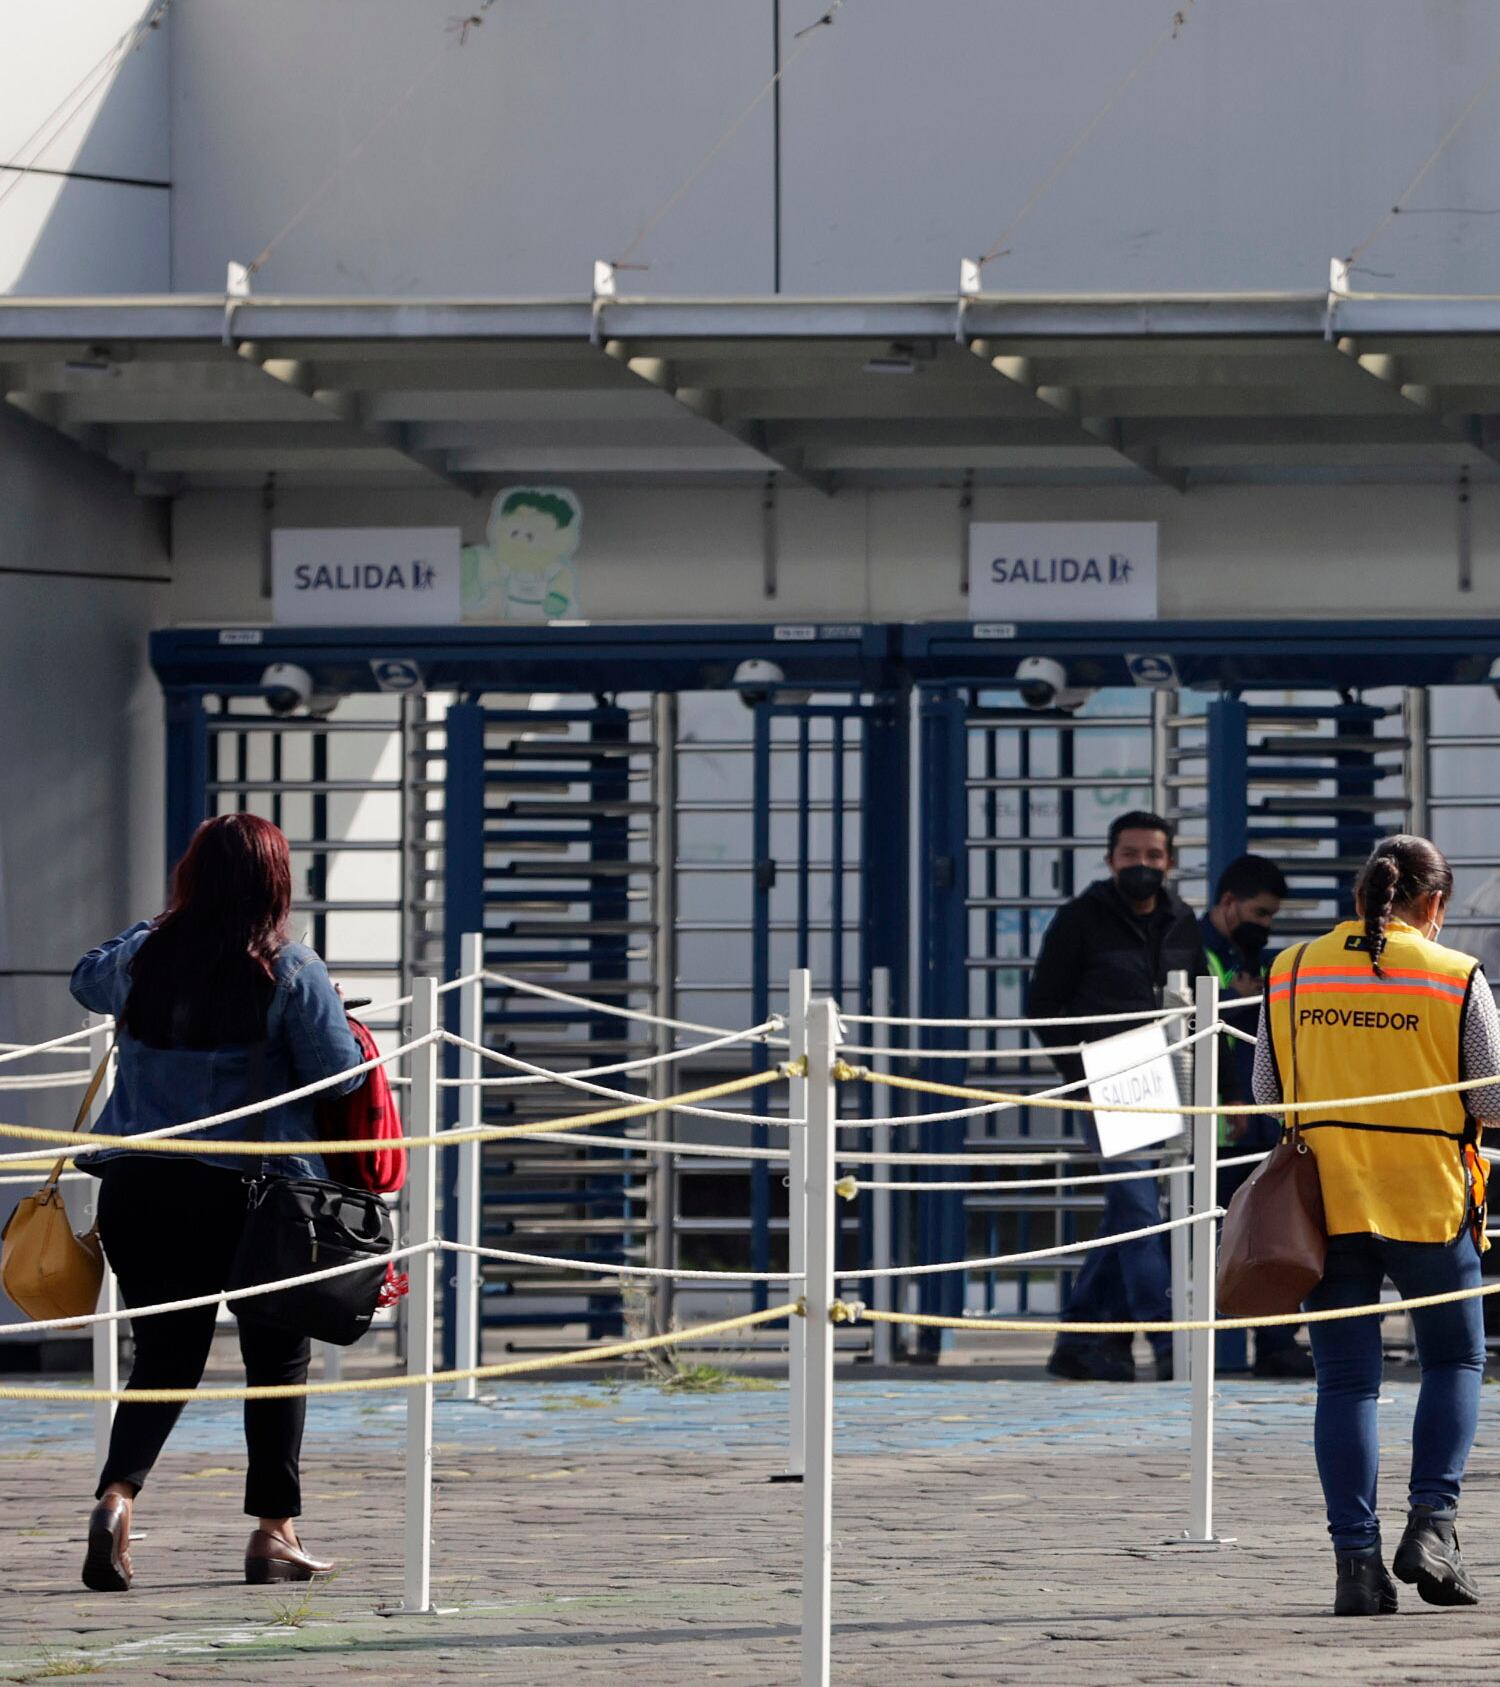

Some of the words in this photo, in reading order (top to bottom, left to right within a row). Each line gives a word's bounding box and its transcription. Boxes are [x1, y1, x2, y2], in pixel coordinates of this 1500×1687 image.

[294, 564, 406, 591] SALIDA
[991, 557, 1103, 584] SALIDA
[1299, 1008, 1420, 1032] PROVEEDOR
[1101, 1074, 1153, 1106] SALIDA
